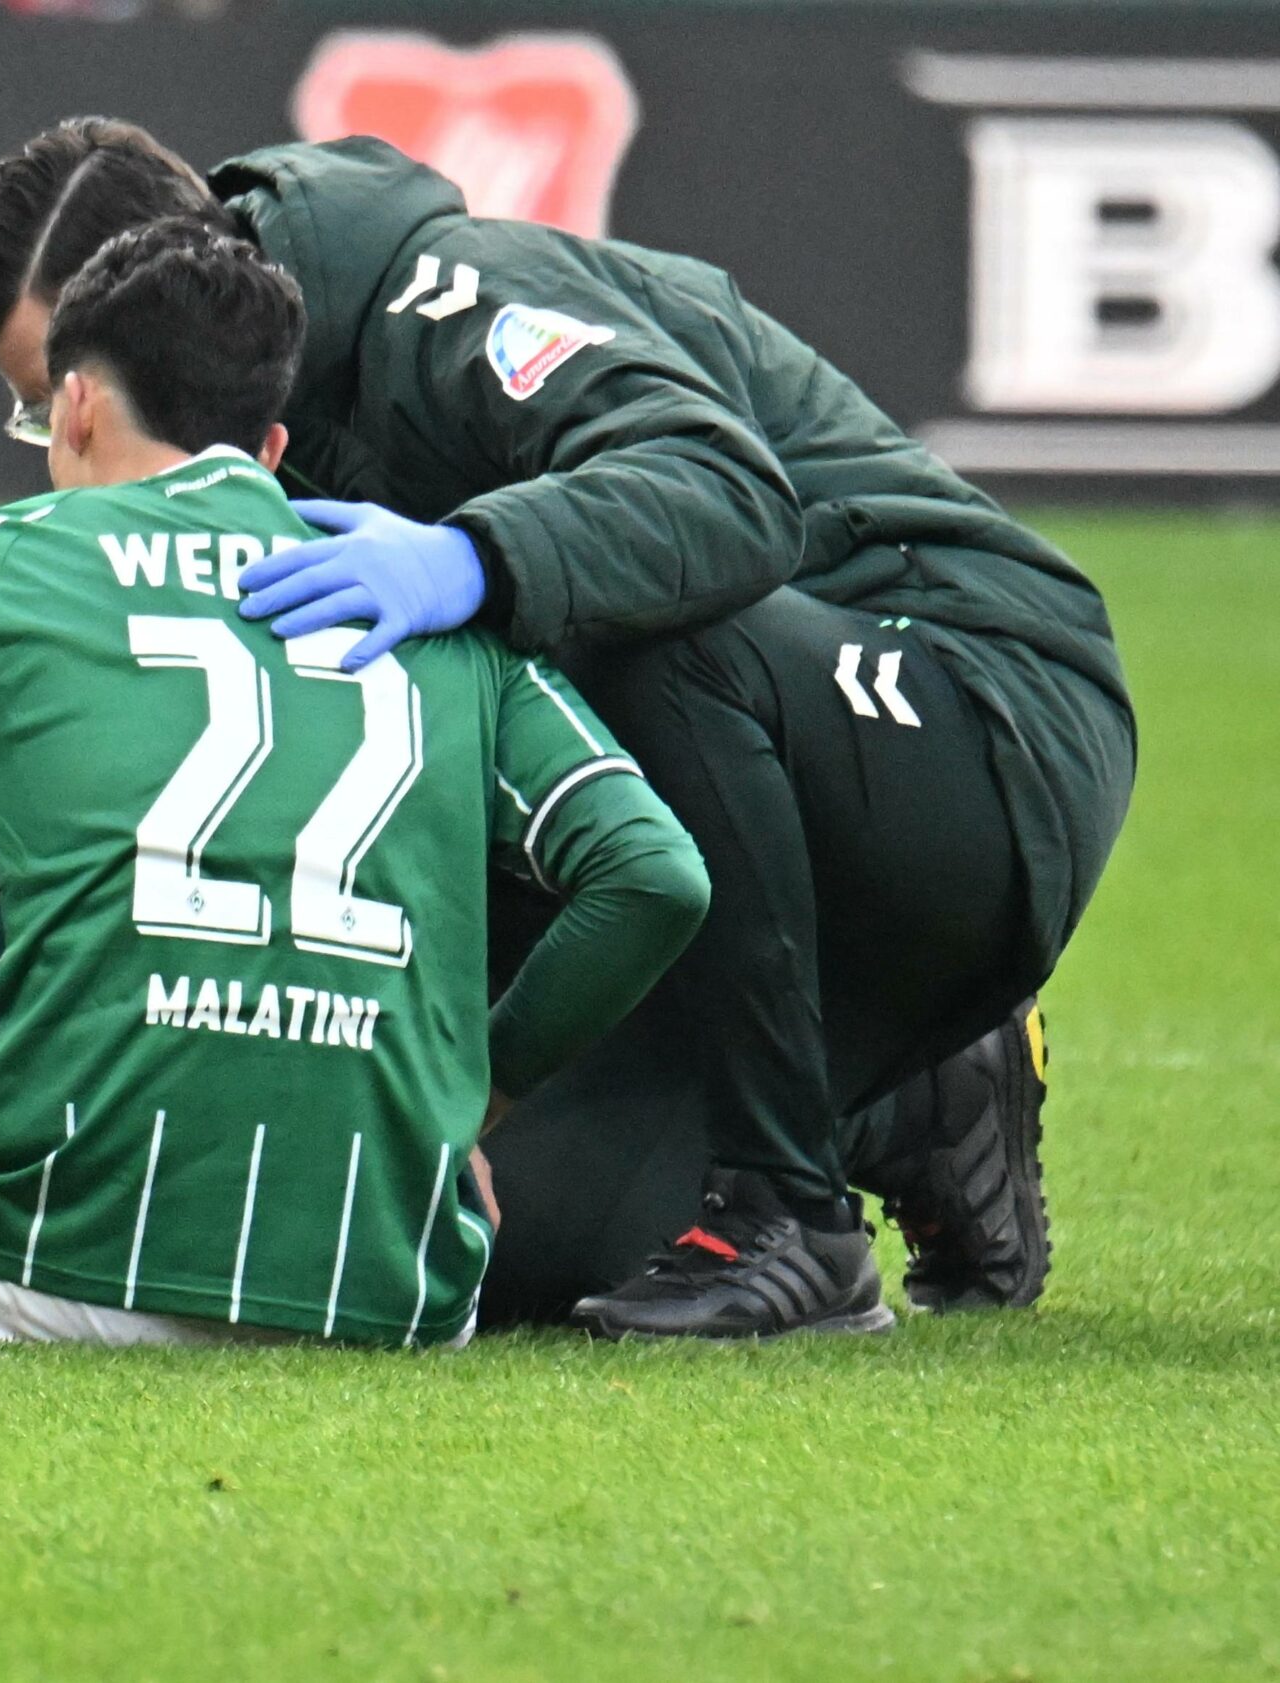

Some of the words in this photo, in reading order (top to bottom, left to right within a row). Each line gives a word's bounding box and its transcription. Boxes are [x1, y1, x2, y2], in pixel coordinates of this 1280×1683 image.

[98, 532, 305, 601] WER
[127, 614, 425, 969] 22
[145, 973, 380, 1051] MALATINI
